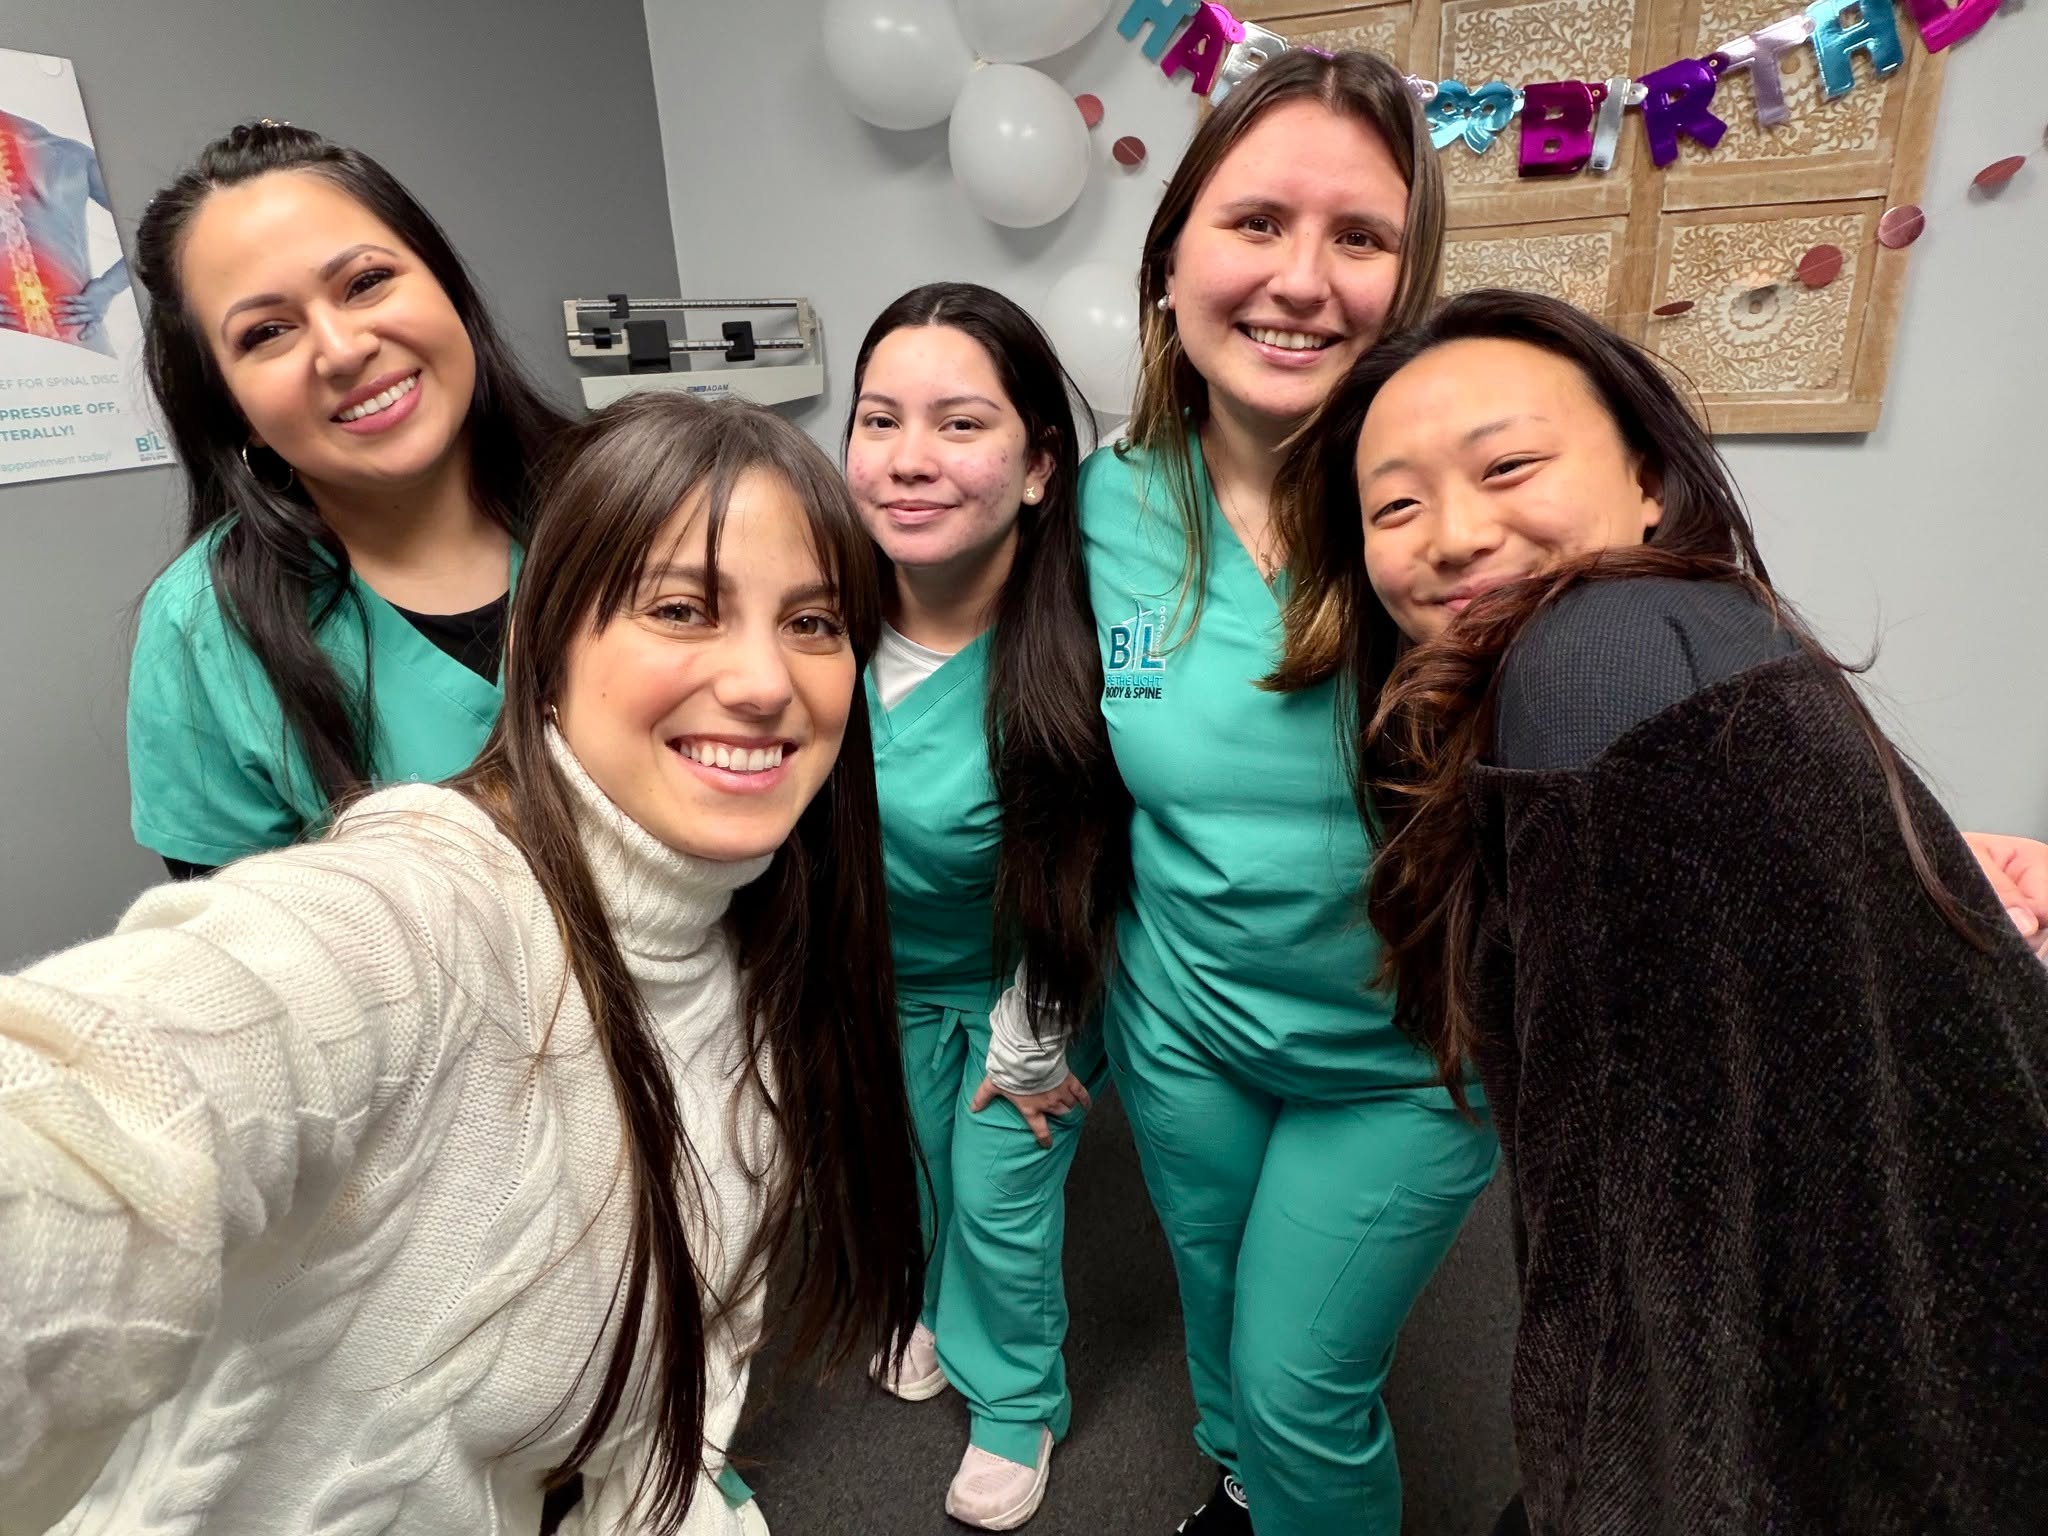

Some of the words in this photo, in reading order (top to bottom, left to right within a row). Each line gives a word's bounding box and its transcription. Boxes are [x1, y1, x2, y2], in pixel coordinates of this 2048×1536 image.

[18, 377, 43, 389] FOR
[47, 375, 88, 387] SPINAL
[91, 374, 119, 385] DISC
[707, 384, 729, 392] ADAM
[0, 404, 83, 421] PRESSURE
[86, 402, 120, 414] OFF,
[1115, 675, 1132, 687] THE
[1105, 686, 1125, 698] BODY
[1124, 686, 1132, 698] &
[1132, 686, 1162, 699] SPINE
